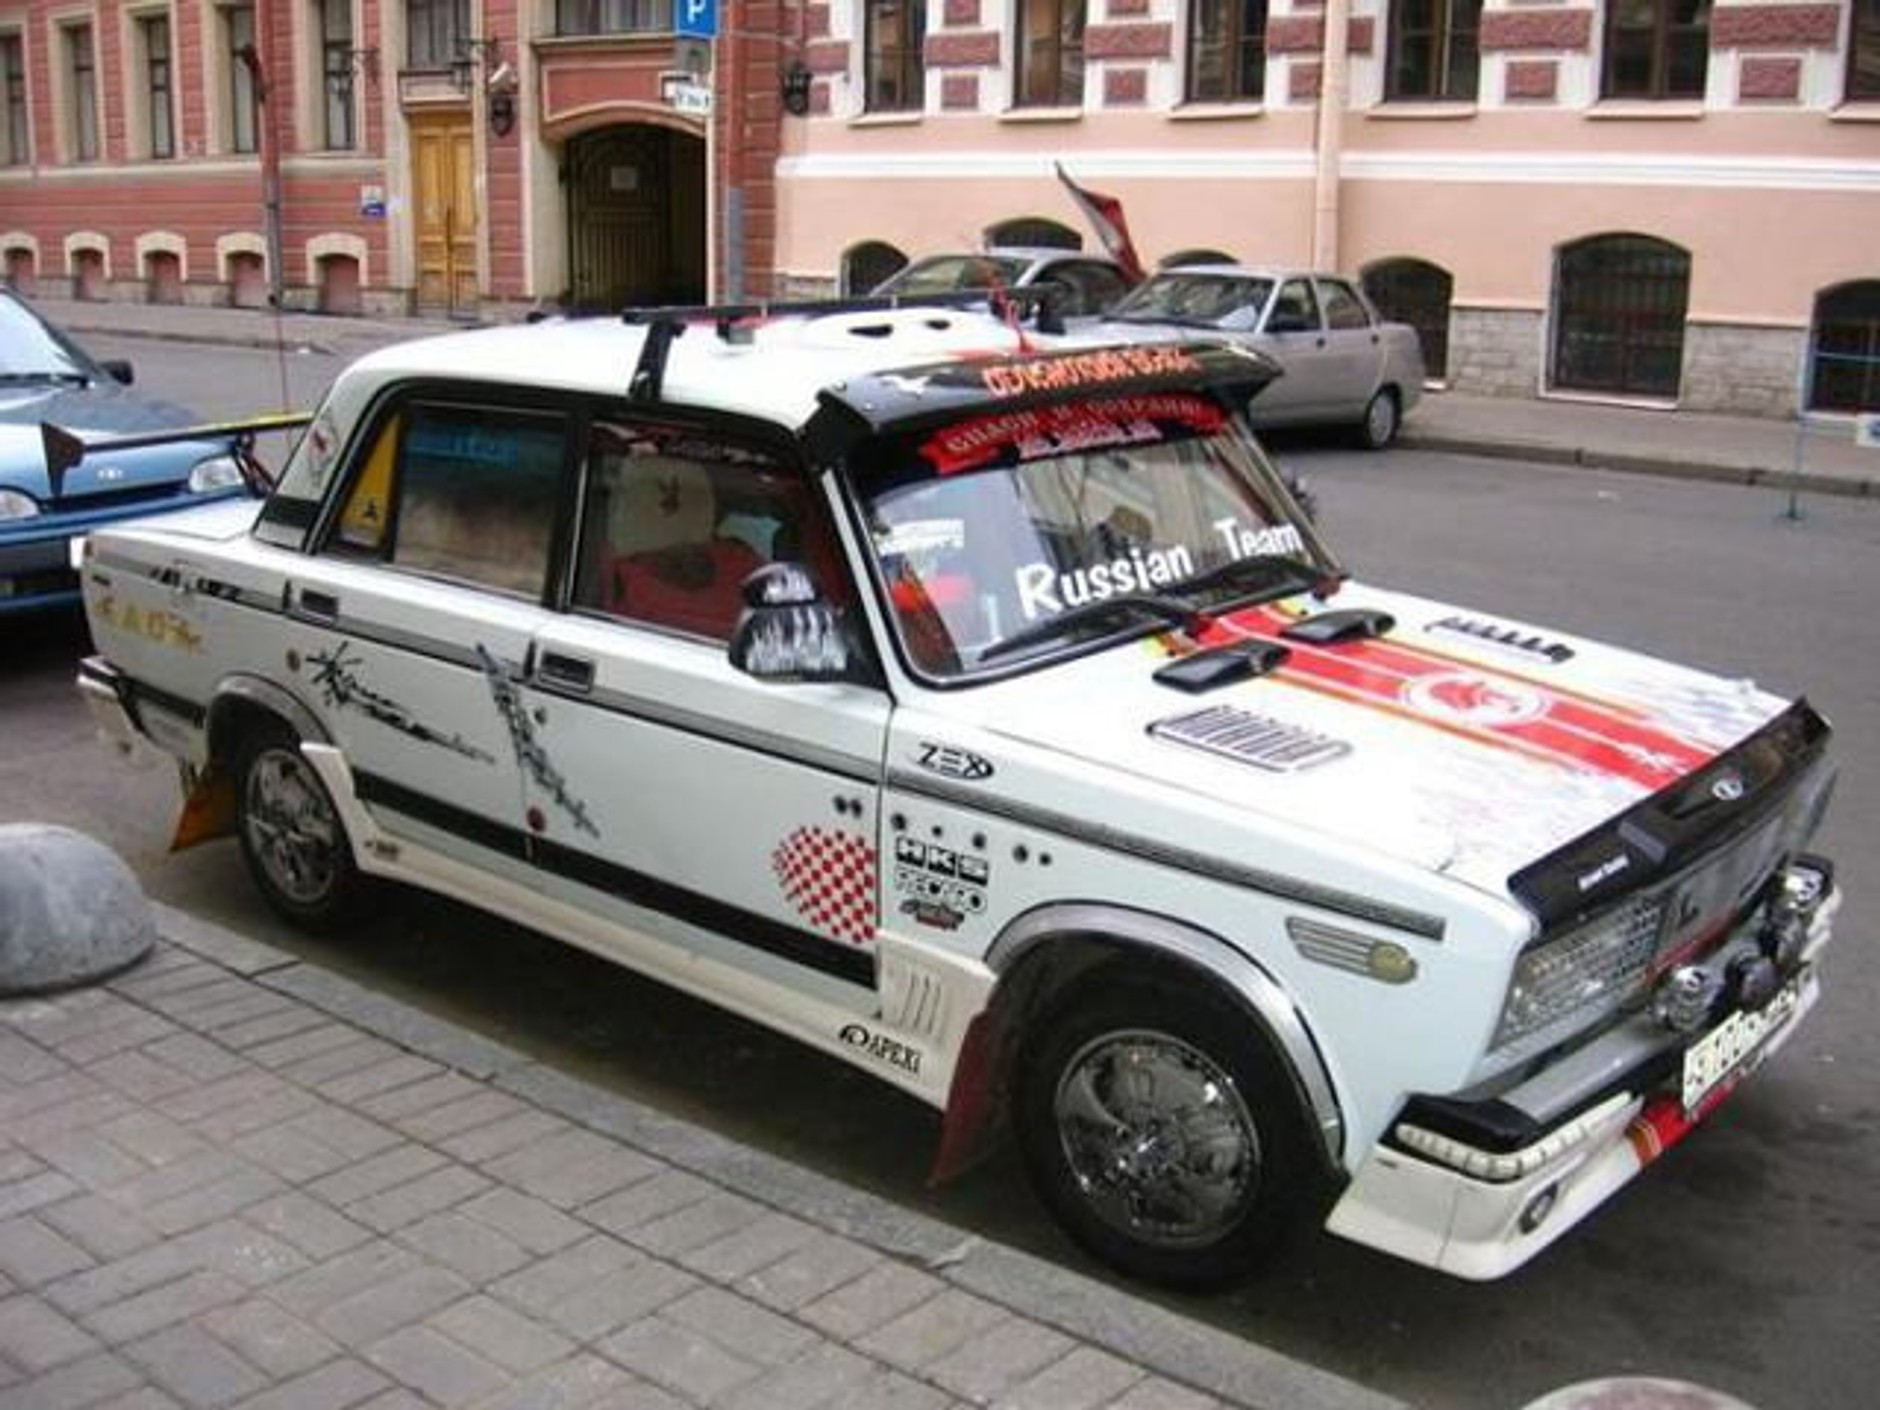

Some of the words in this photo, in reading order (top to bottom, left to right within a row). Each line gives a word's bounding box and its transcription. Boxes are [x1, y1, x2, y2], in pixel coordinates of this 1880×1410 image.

[1015, 545, 1194, 619] Russian
[1213, 517, 1304, 562] Team
[896, 836, 989, 888] HKS
